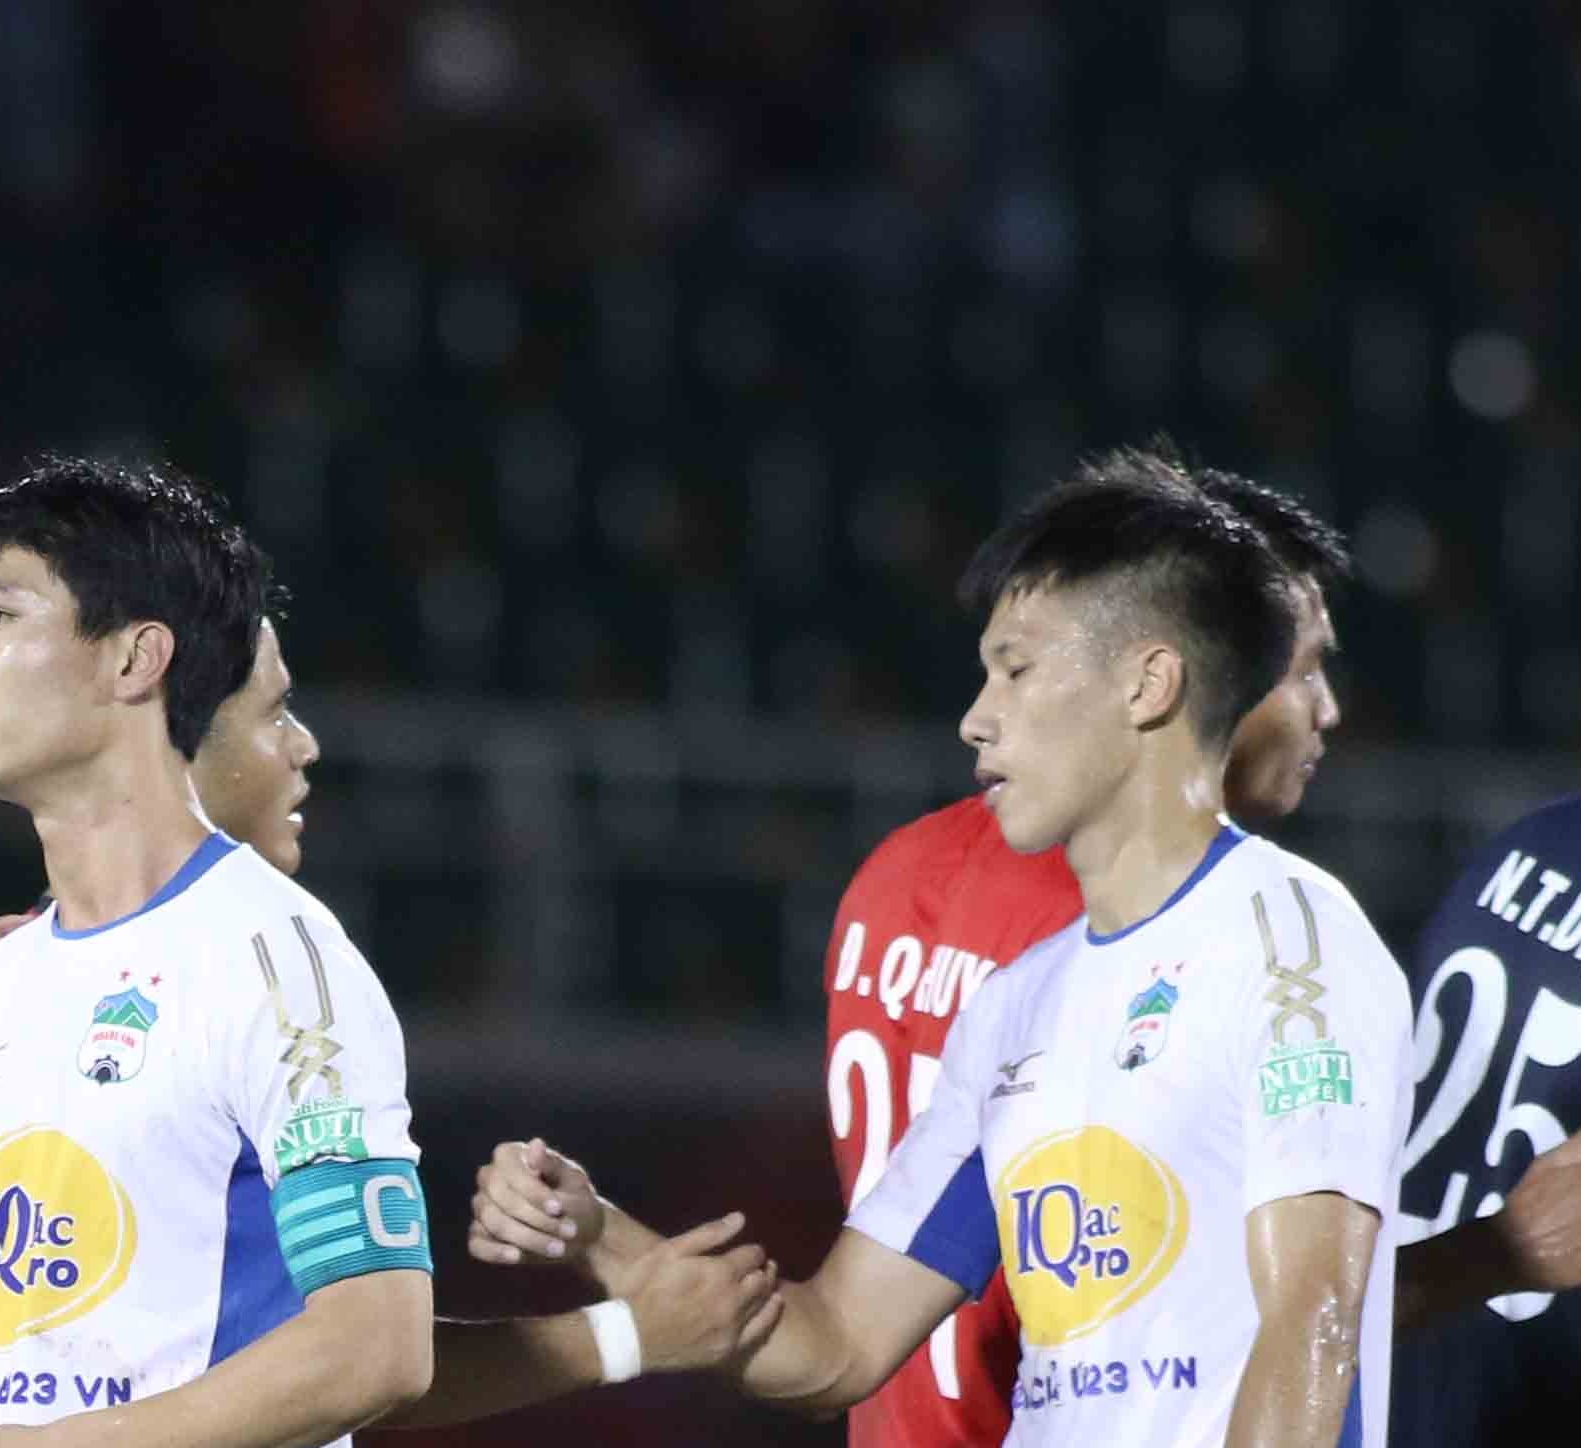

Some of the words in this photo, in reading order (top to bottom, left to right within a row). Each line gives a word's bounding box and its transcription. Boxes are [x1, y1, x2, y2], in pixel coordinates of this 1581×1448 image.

[274, 1110, 363, 1153] NUTI
[363, 1174, 422, 1248] C
[1010, 1183, 1079, 1289] IQ
[26, 1255, 80, 1289] ro
[73, 1374, 133, 1408] VN
[1141, 1356, 1198, 1390] VN
